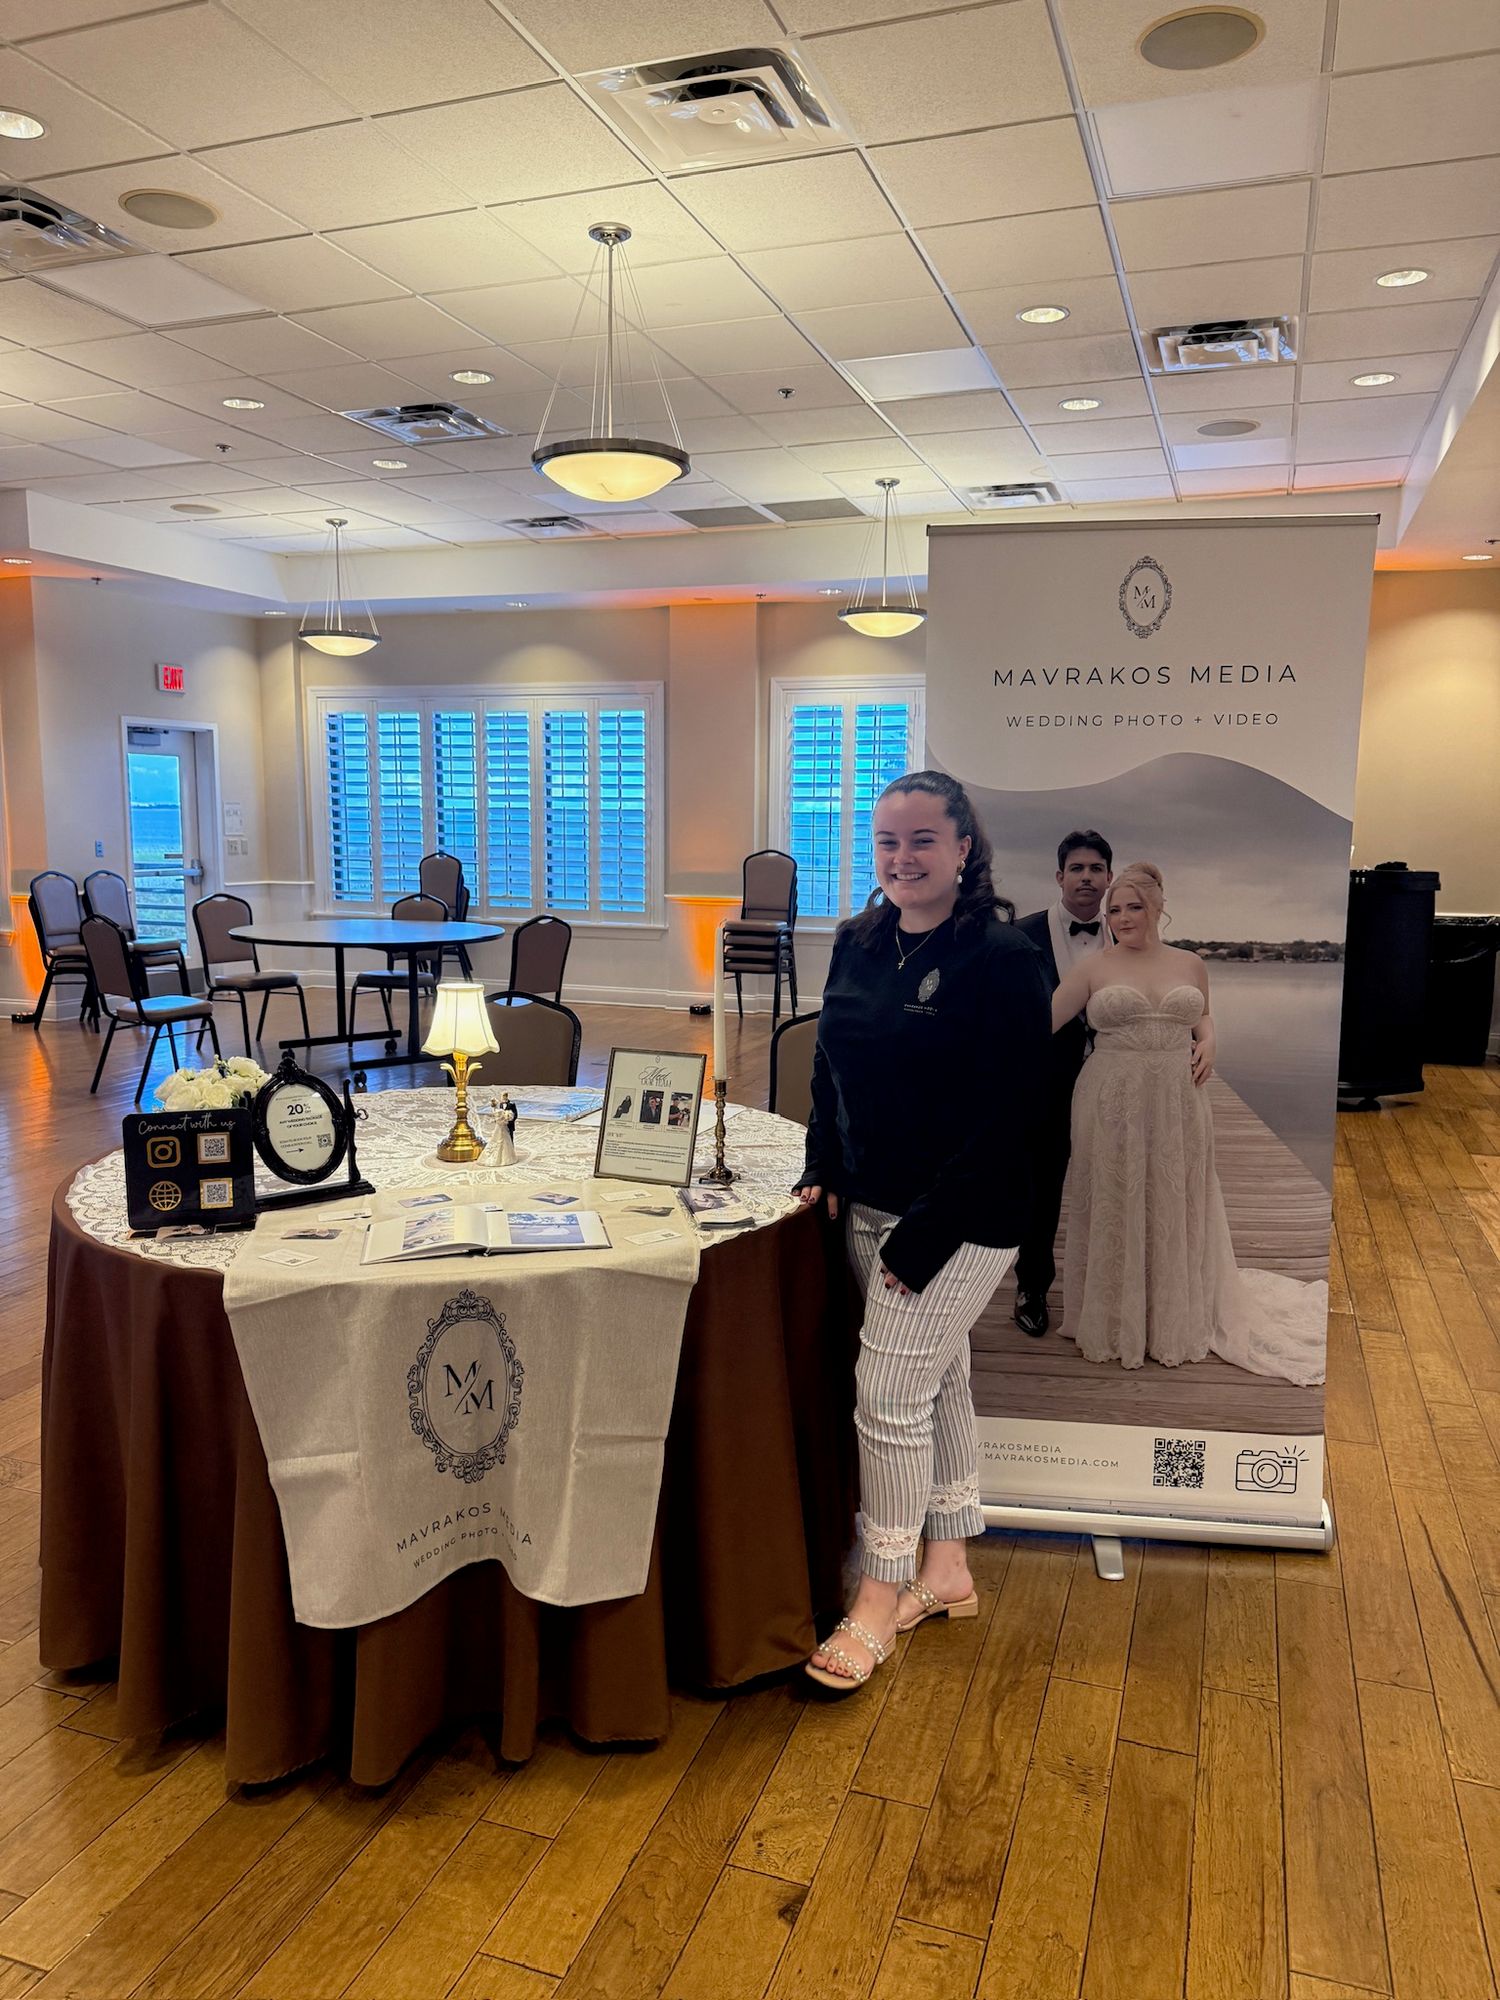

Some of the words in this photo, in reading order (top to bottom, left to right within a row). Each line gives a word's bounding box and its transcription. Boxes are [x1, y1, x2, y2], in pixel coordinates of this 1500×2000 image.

[162, 665, 184, 690] EXIT
[993, 666, 1171, 687] MAVRAKOS
[1190, 664, 1297, 684] MEDIA
[1005, 714, 1104, 728] WEDDING
[1113, 713, 1184, 727] PHOTO
[1213, 712, 1279, 726] VIDEO
[286, 1103, 304, 1116] 20
[138, 1114, 192, 1136] Connect
[190, 1112, 217, 1130] with
[220, 1119, 237, 1131] us
[984, 1452, 1120, 1468] MAVRAKOSMEDIA.COM
[396, 1501, 492, 1553] MAVRAKOS
[413, 1536, 457, 1569] WEDDING
[461, 1526, 499, 1541] PHOTO
